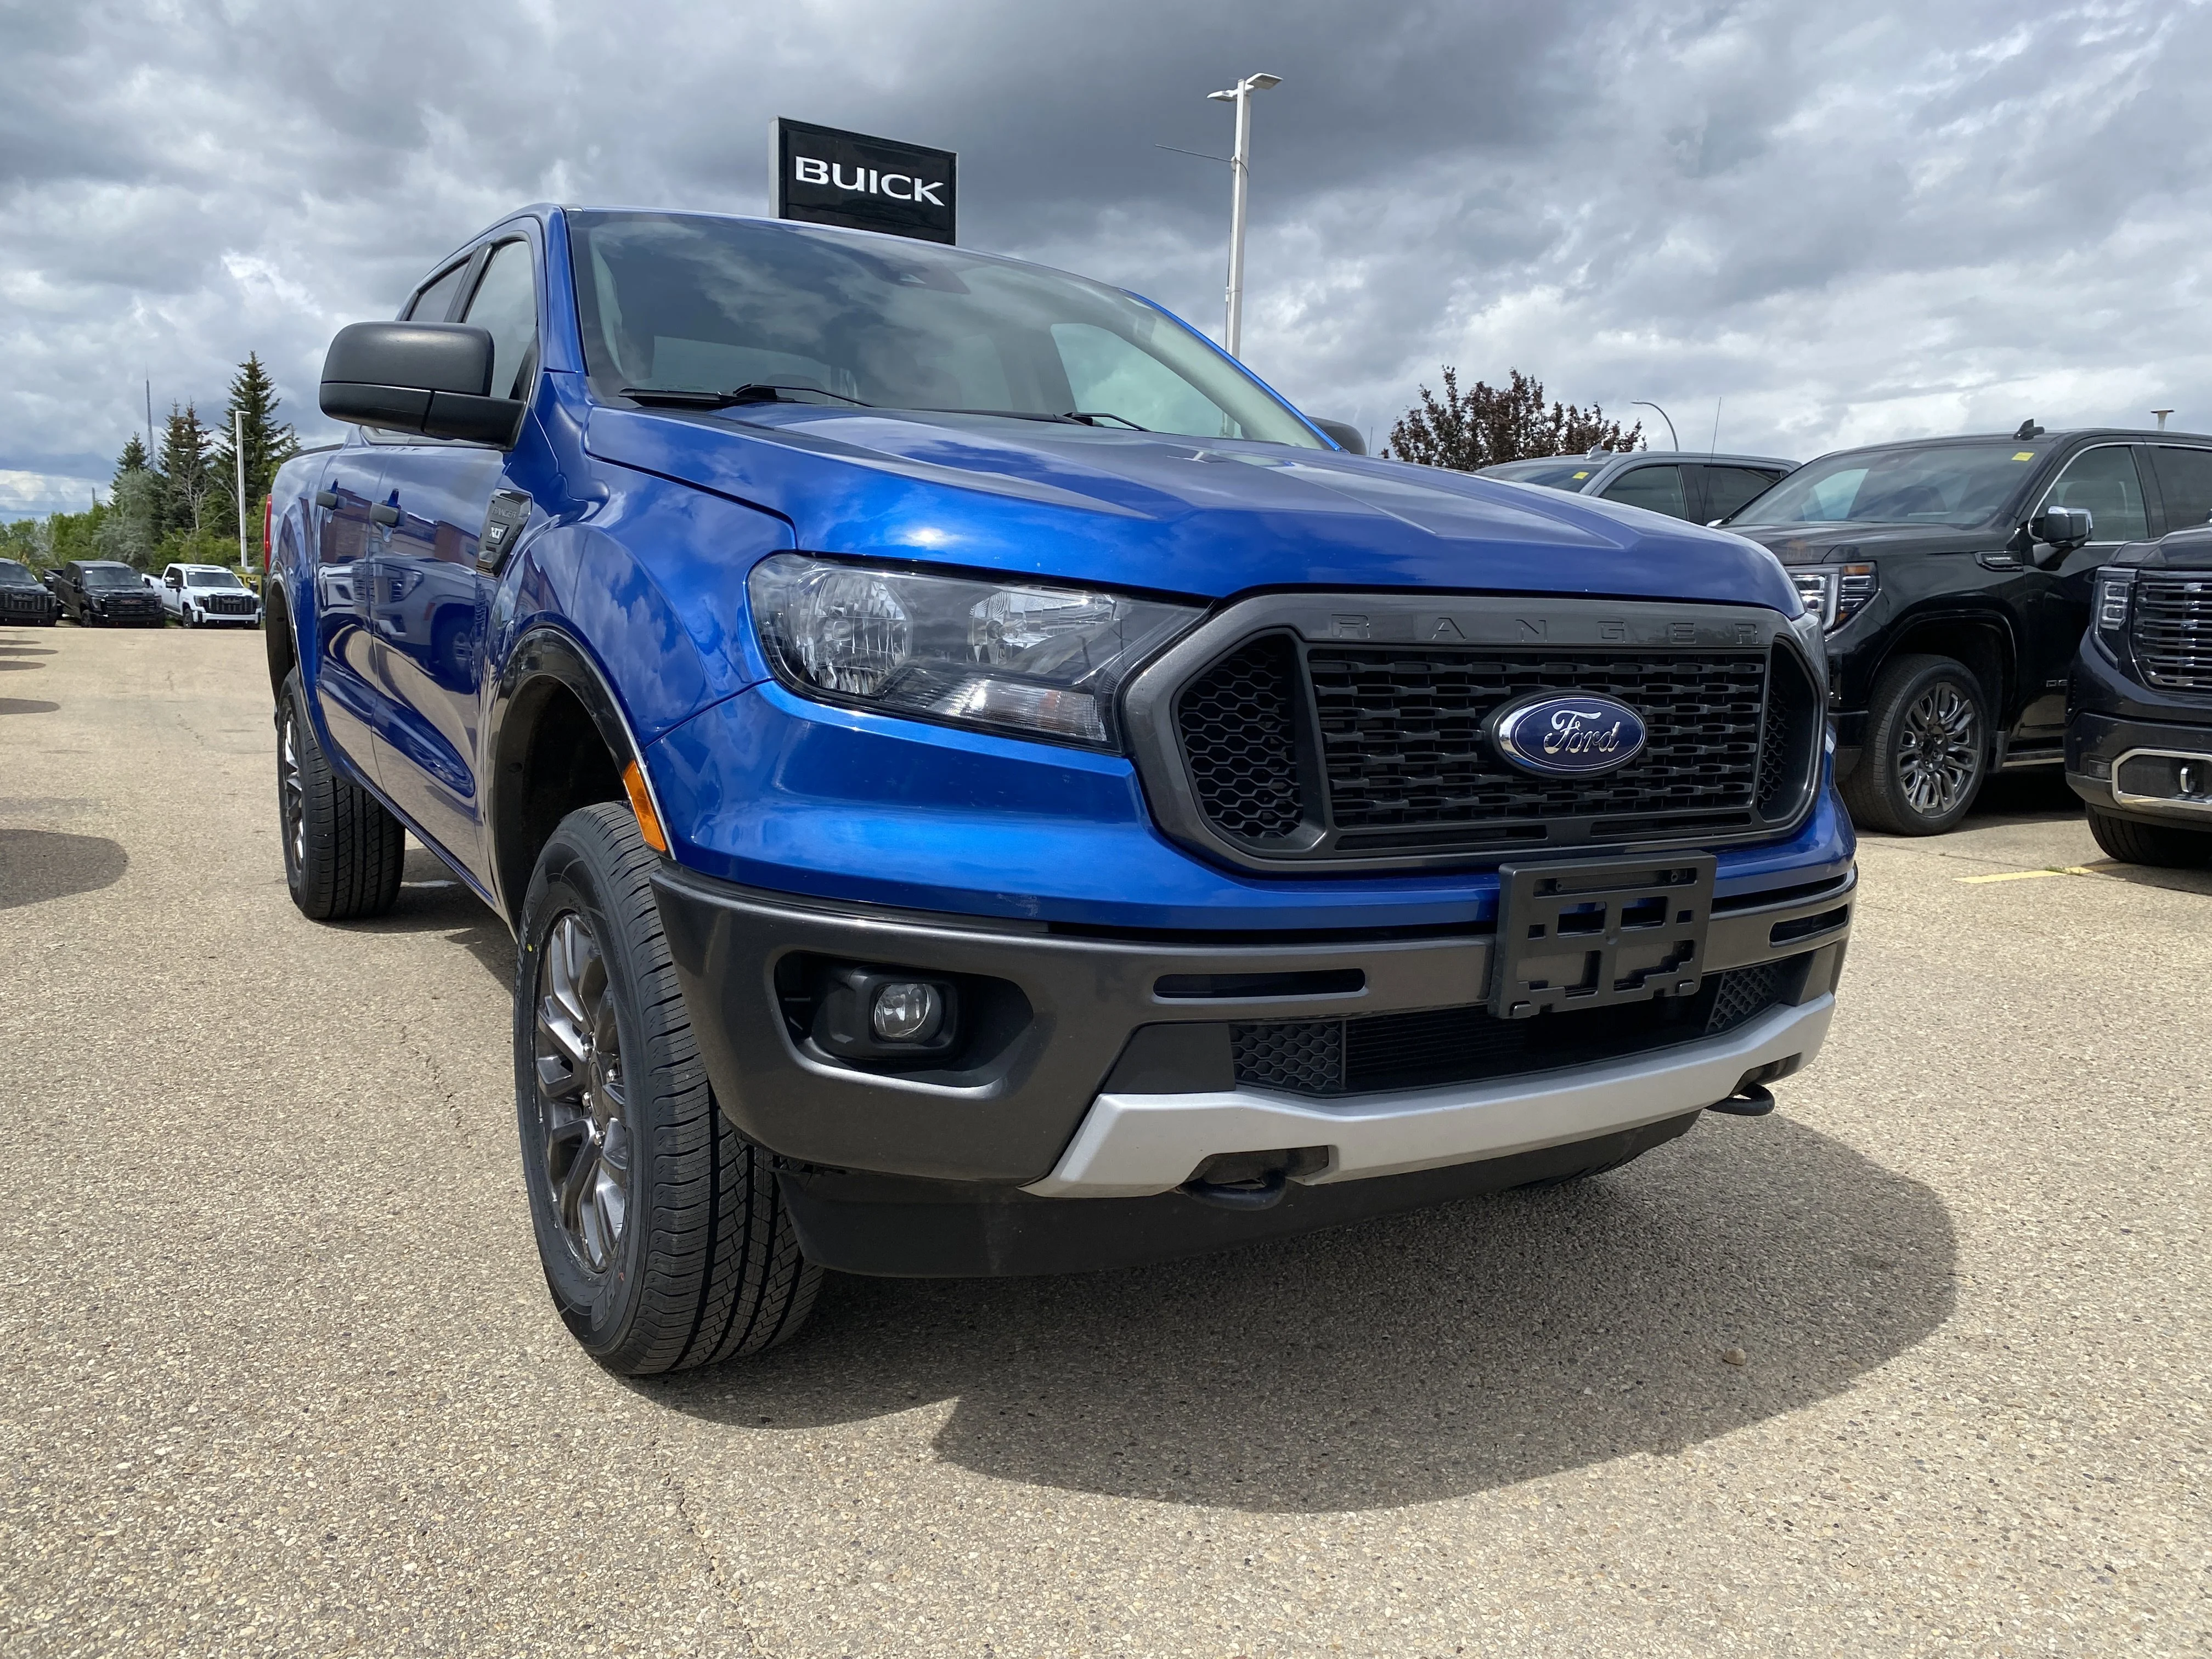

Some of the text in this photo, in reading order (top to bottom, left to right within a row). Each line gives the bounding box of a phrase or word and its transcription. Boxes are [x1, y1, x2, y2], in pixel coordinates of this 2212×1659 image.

[795, 155, 945, 206] BUICK
[492, 506, 517, 518] RANGER
[489, 527, 504, 539] XLT
[1331, 614, 1759, 645] RANGER
[1543, 709, 1621, 754] Ford
